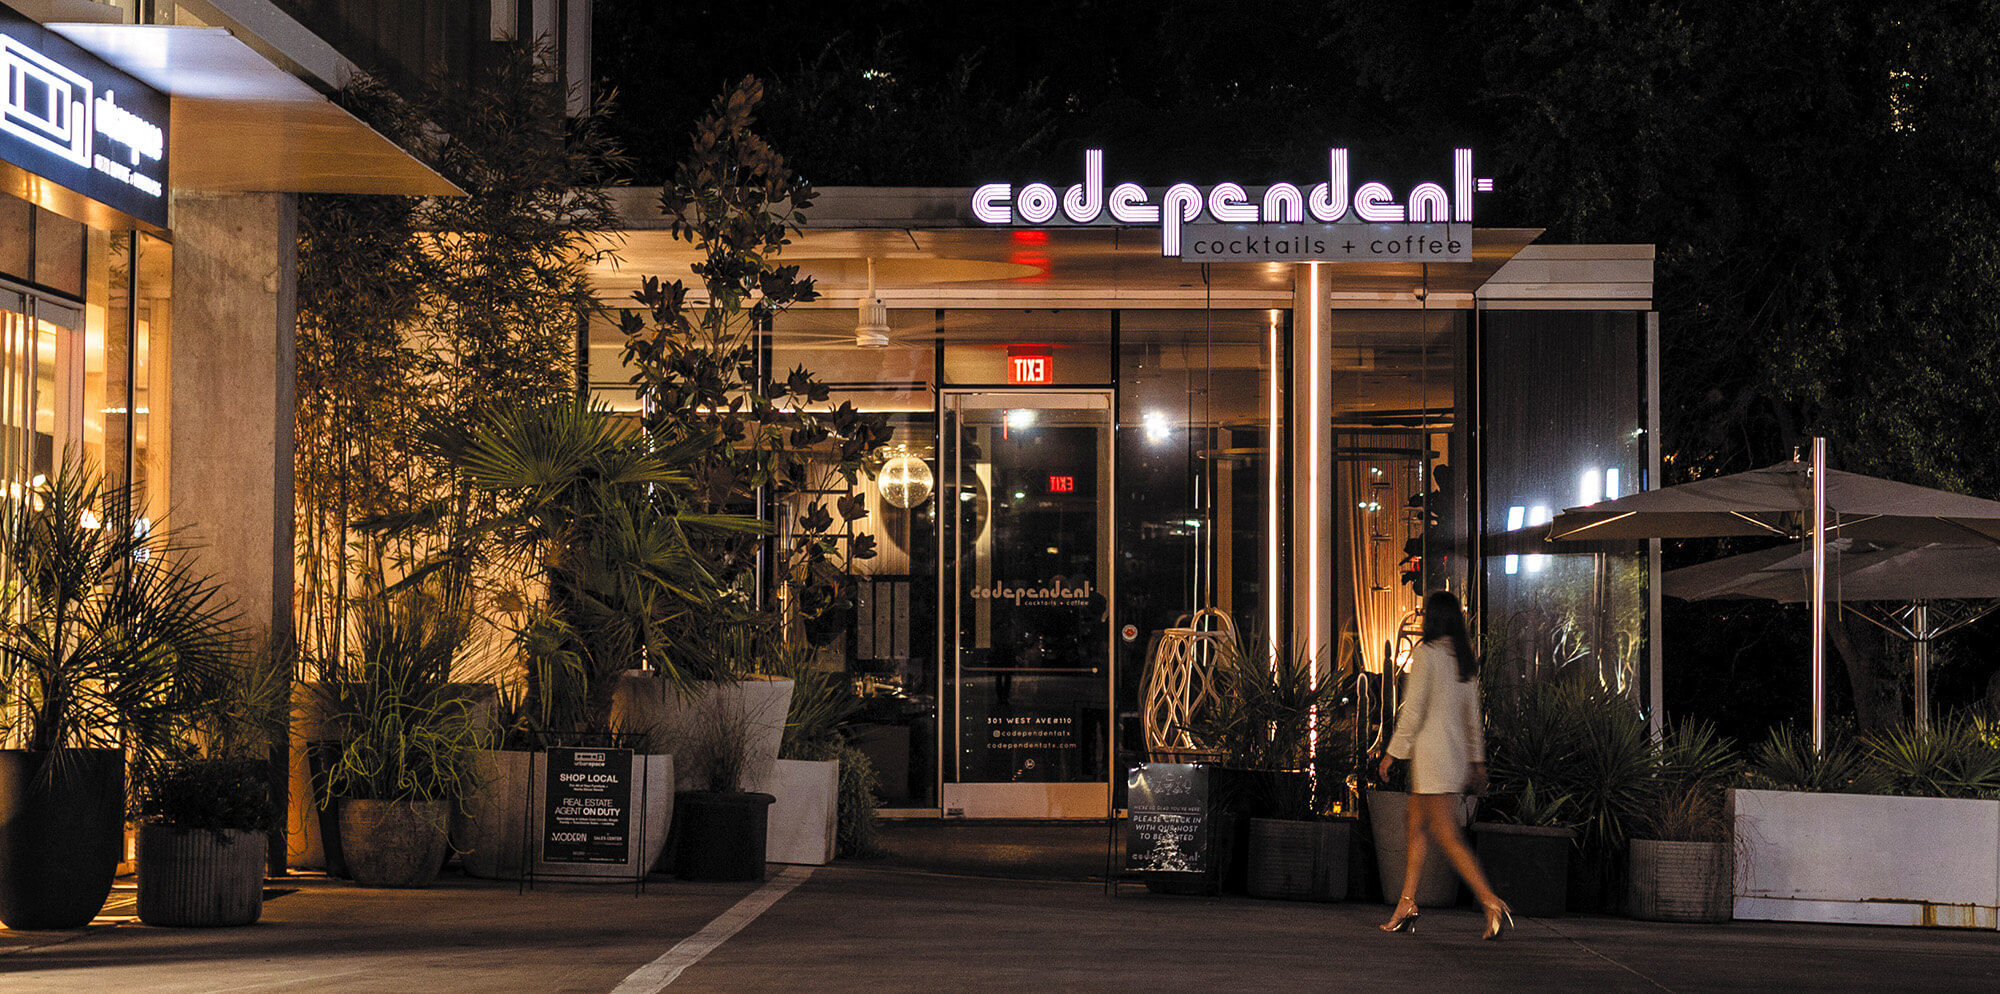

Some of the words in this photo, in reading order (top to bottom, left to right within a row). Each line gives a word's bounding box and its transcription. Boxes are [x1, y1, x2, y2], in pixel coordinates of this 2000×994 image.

[970, 147, 1493, 258] codependent
[1193, 234, 1326, 255] cocktails
[1341, 239, 1356, 254] +
[1370, 234, 1463, 255] coffee
[970, 580, 1094, 606] codependent
[1006, 717, 1031, 725] WEST
[986, 742, 1077, 750] codependentatx.com
[560, 773, 586, 782] SHOP
[587, 774, 619, 783] LOCAL
[563, 798, 584, 807] REAL
[584, 798, 613, 808] ESTATE
[554, 806, 582, 815] AGENT
[582, 807, 597, 816] ON
[597, 807, 621, 817] DUTY
[1133, 815, 1162, 823] PLEASE
[1163, 815, 1191, 823] CHECK
[1135, 823, 1156, 831] WITH
[1157, 824, 1175, 832] OUR
[551, 832, 587, 842] MODERN
[1139, 832, 1151, 840] TO
[1152, 833, 1163, 841] BE
